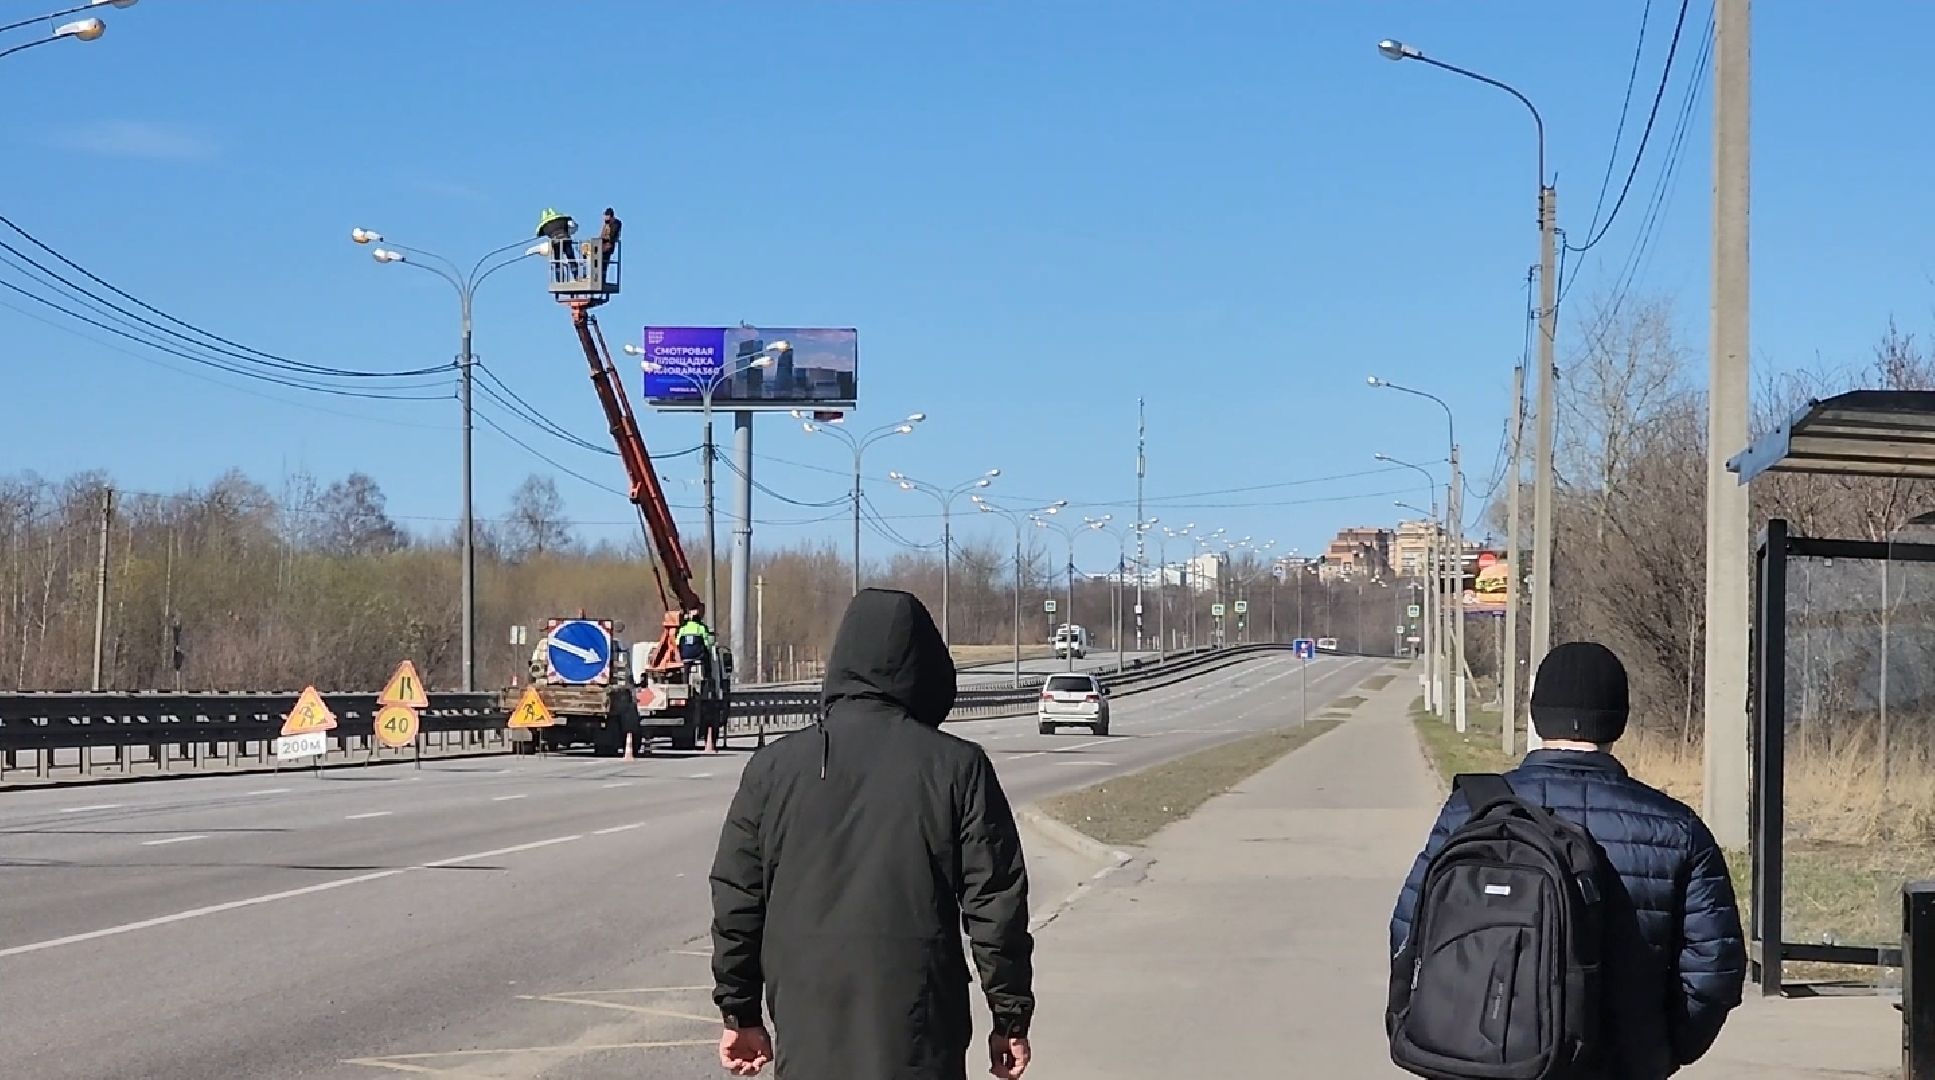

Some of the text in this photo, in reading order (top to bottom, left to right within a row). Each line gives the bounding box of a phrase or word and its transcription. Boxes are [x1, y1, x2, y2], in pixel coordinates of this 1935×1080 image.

[655, 347, 714, 356] СМОТРОВАЯ
[654, 357, 714, 366] ПЛОЩАДКА
[384, 717, 409, 734] 40
